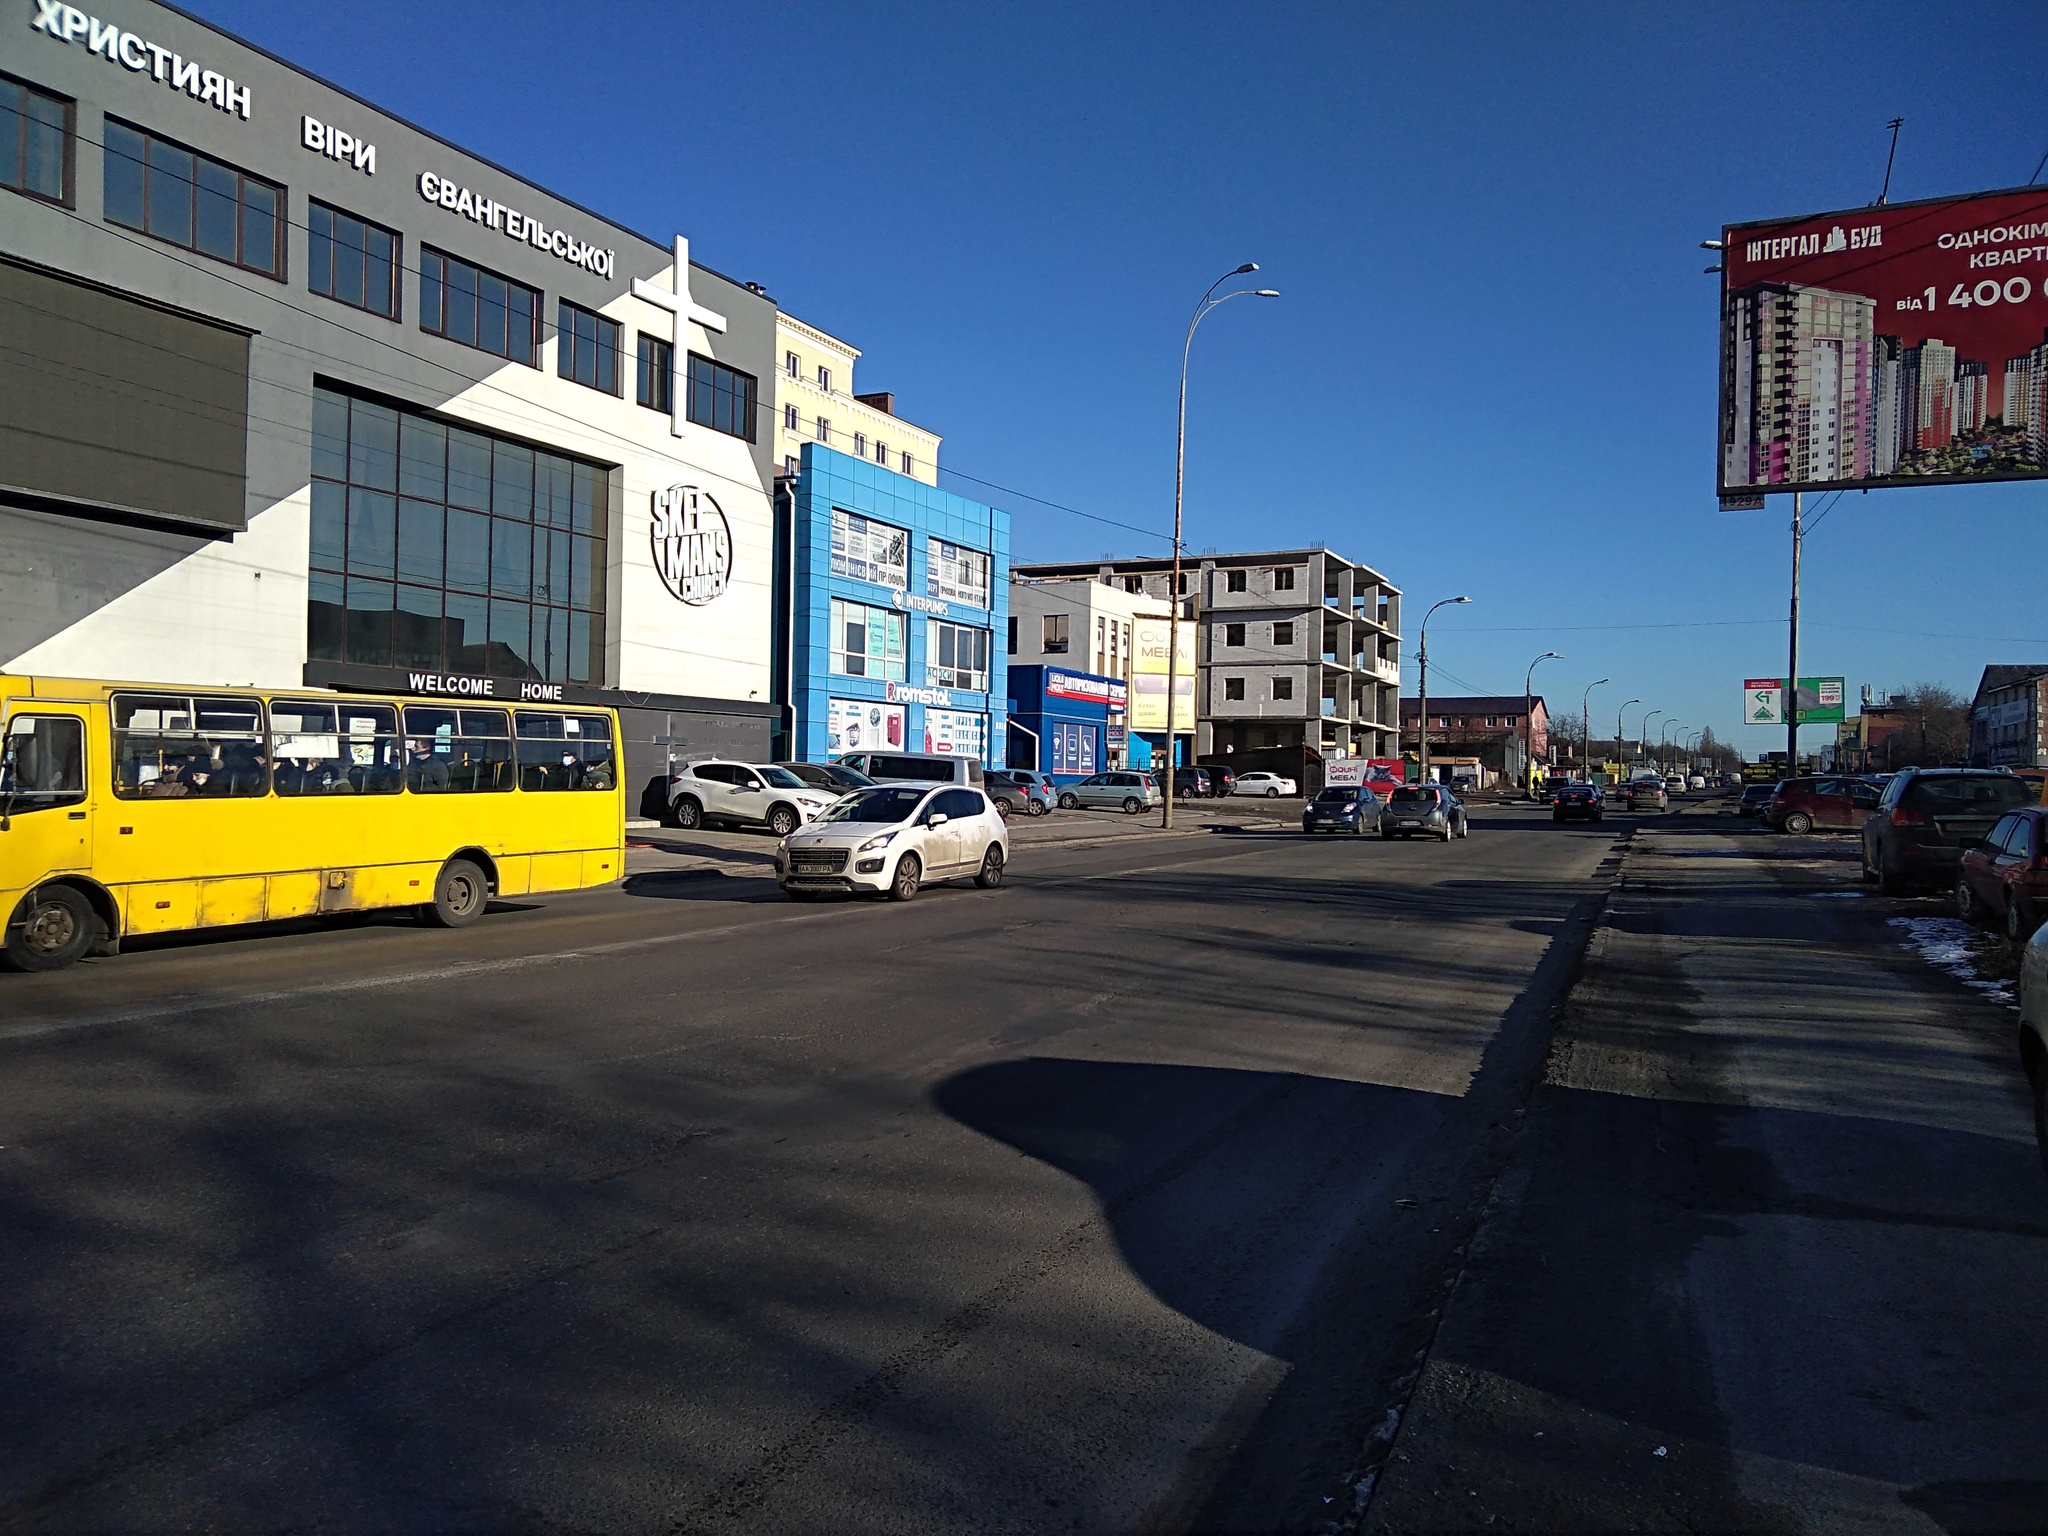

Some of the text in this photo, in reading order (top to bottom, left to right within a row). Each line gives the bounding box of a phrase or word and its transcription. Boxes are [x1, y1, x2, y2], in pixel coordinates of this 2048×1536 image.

[31, 0, 616, 280] ХРИСТИЯН ВІРИ ЄВАНГЕЛЬСЬКОЇ
[1746, 225, 1883, 263] ІНТЕРГАЛ БУД
[1969, 245, 2048, 269] КВАРТ
[1896, 296, 1923, 311] від
[1923, 286, 1936, 312] 1
[1947, 276, 2032, 309] 400
[906, 594, 949, 616] INTERPUMPS
[409, 672, 563, 700] WELCOME HOME
